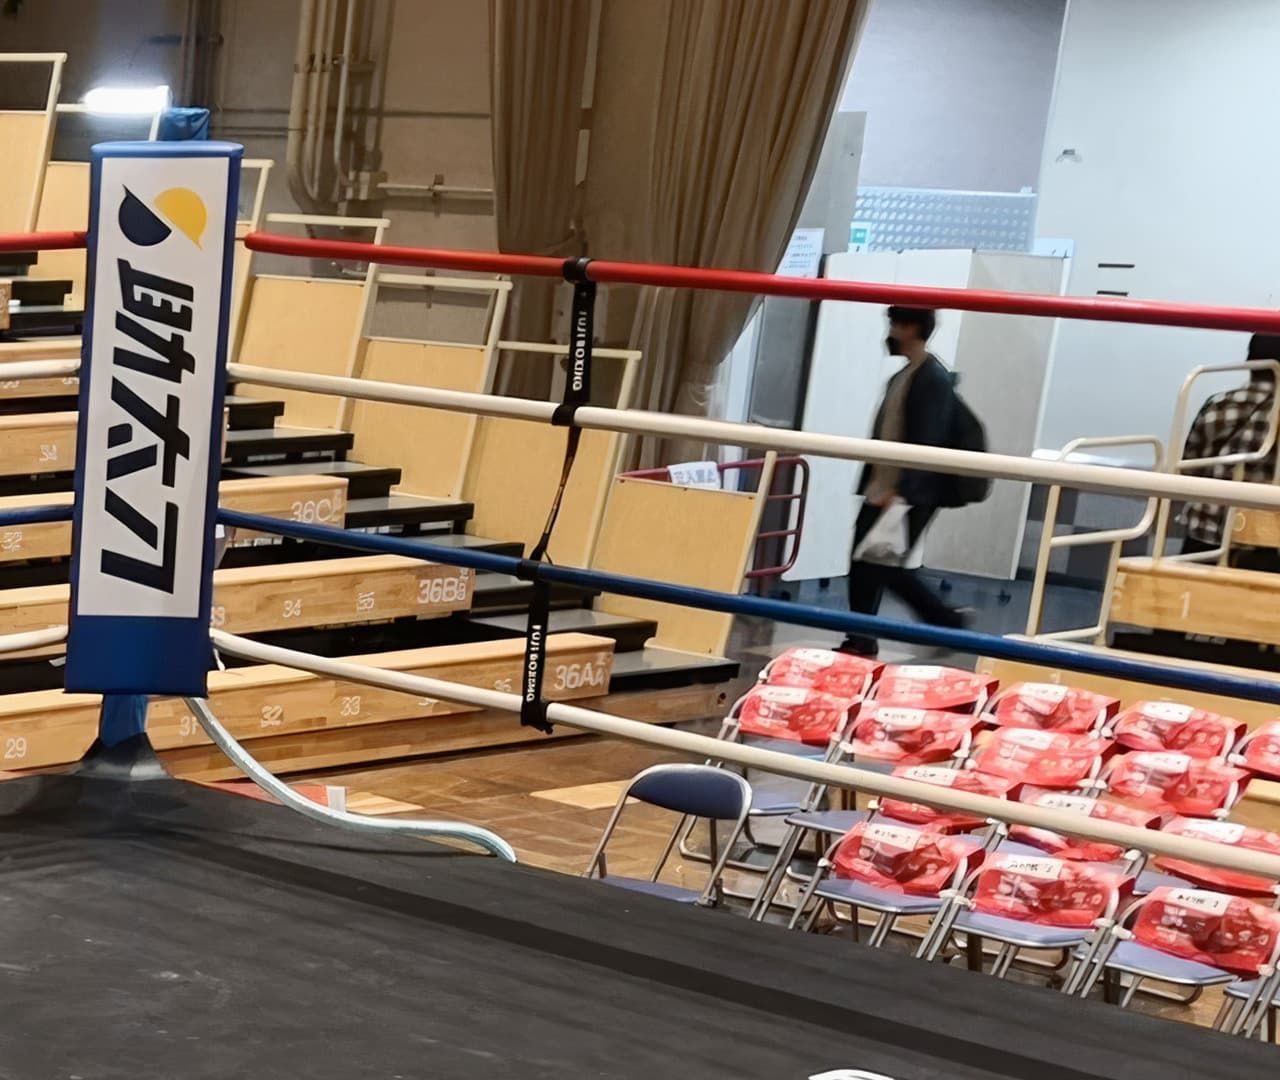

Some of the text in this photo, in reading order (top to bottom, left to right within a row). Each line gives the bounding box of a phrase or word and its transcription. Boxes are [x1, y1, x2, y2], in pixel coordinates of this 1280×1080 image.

[290, 499, 335, 521] 36C
[417, 578, 458, 604] 36B
[5, 738, 27, 759] 29
